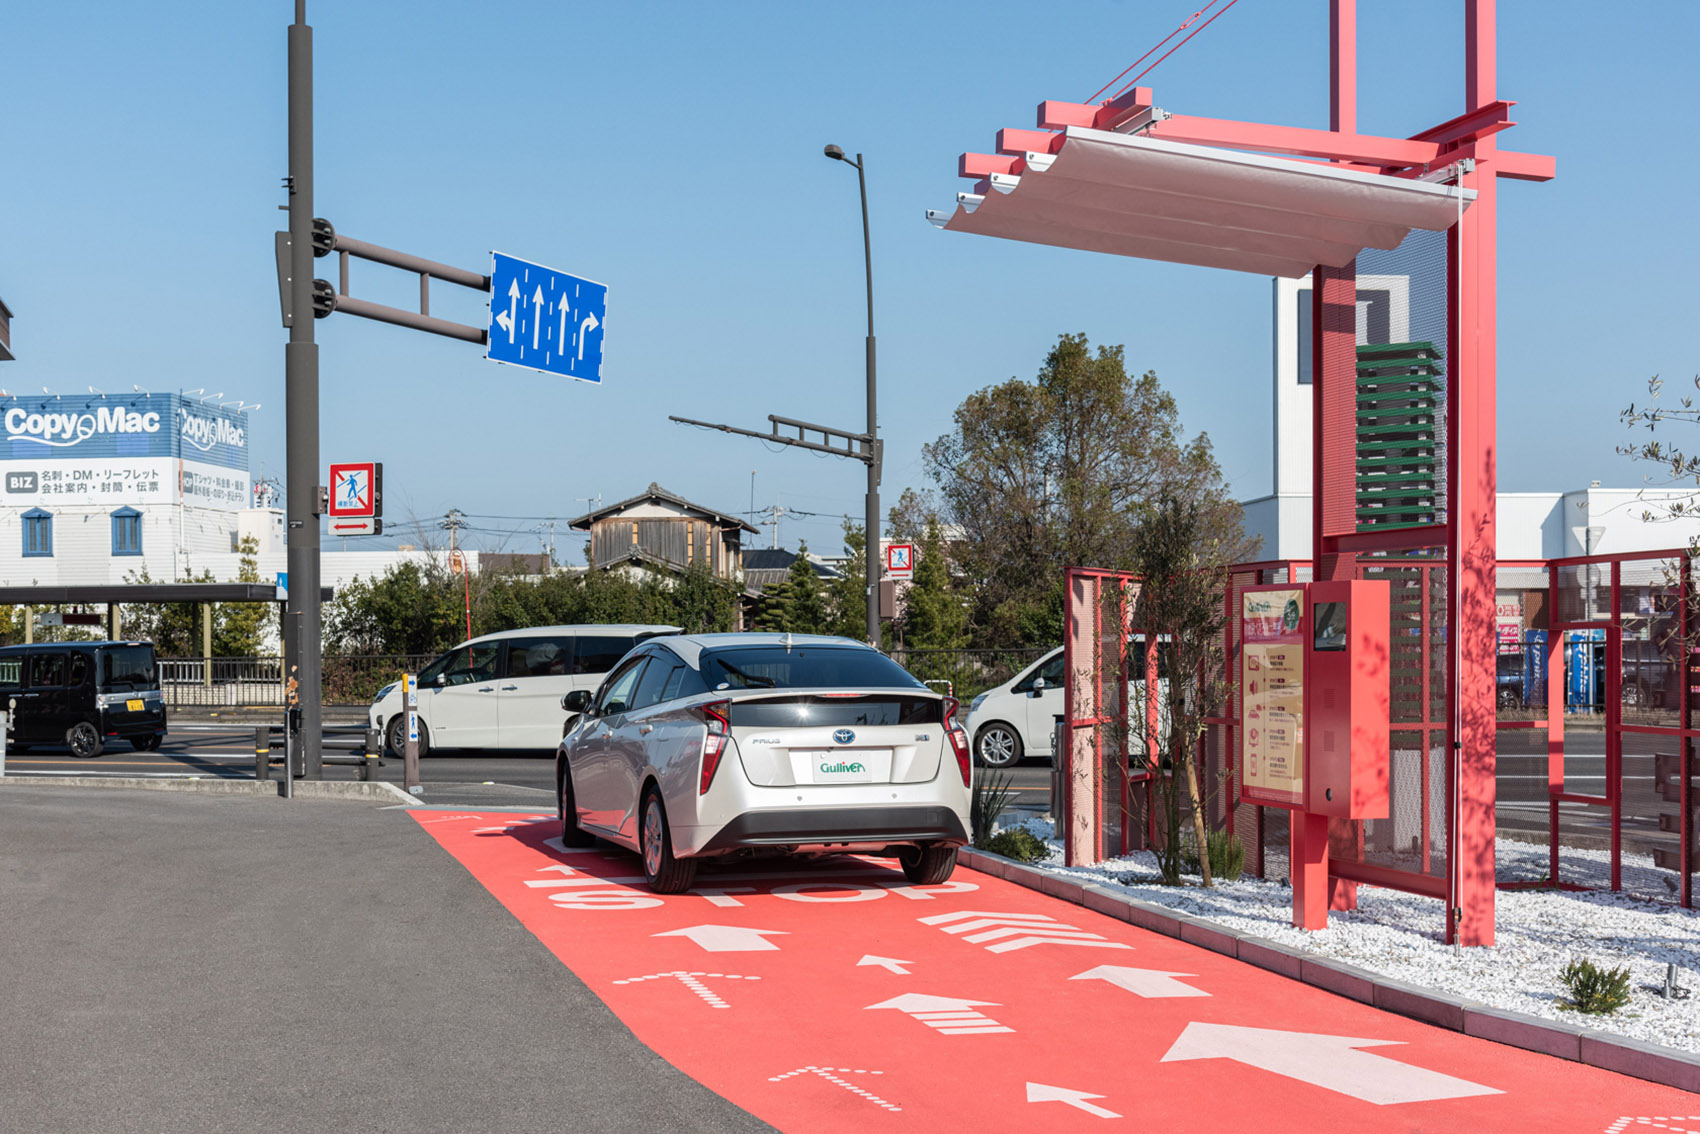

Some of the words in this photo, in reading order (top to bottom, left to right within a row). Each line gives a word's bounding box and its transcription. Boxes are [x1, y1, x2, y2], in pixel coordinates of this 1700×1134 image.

[4, 408, 78, 439] Copy
[97, 407, 160, 433] Mac
[217, 417, 244, 447] Mac
[41, 469, 159, 481] 名刺・DM・リーフレット
[10, 476, 33, 489] BIZ
[41, 481, 159, 494] 会社案内・封筒・伝票
[820, 761, 865, 774] Gulliver
